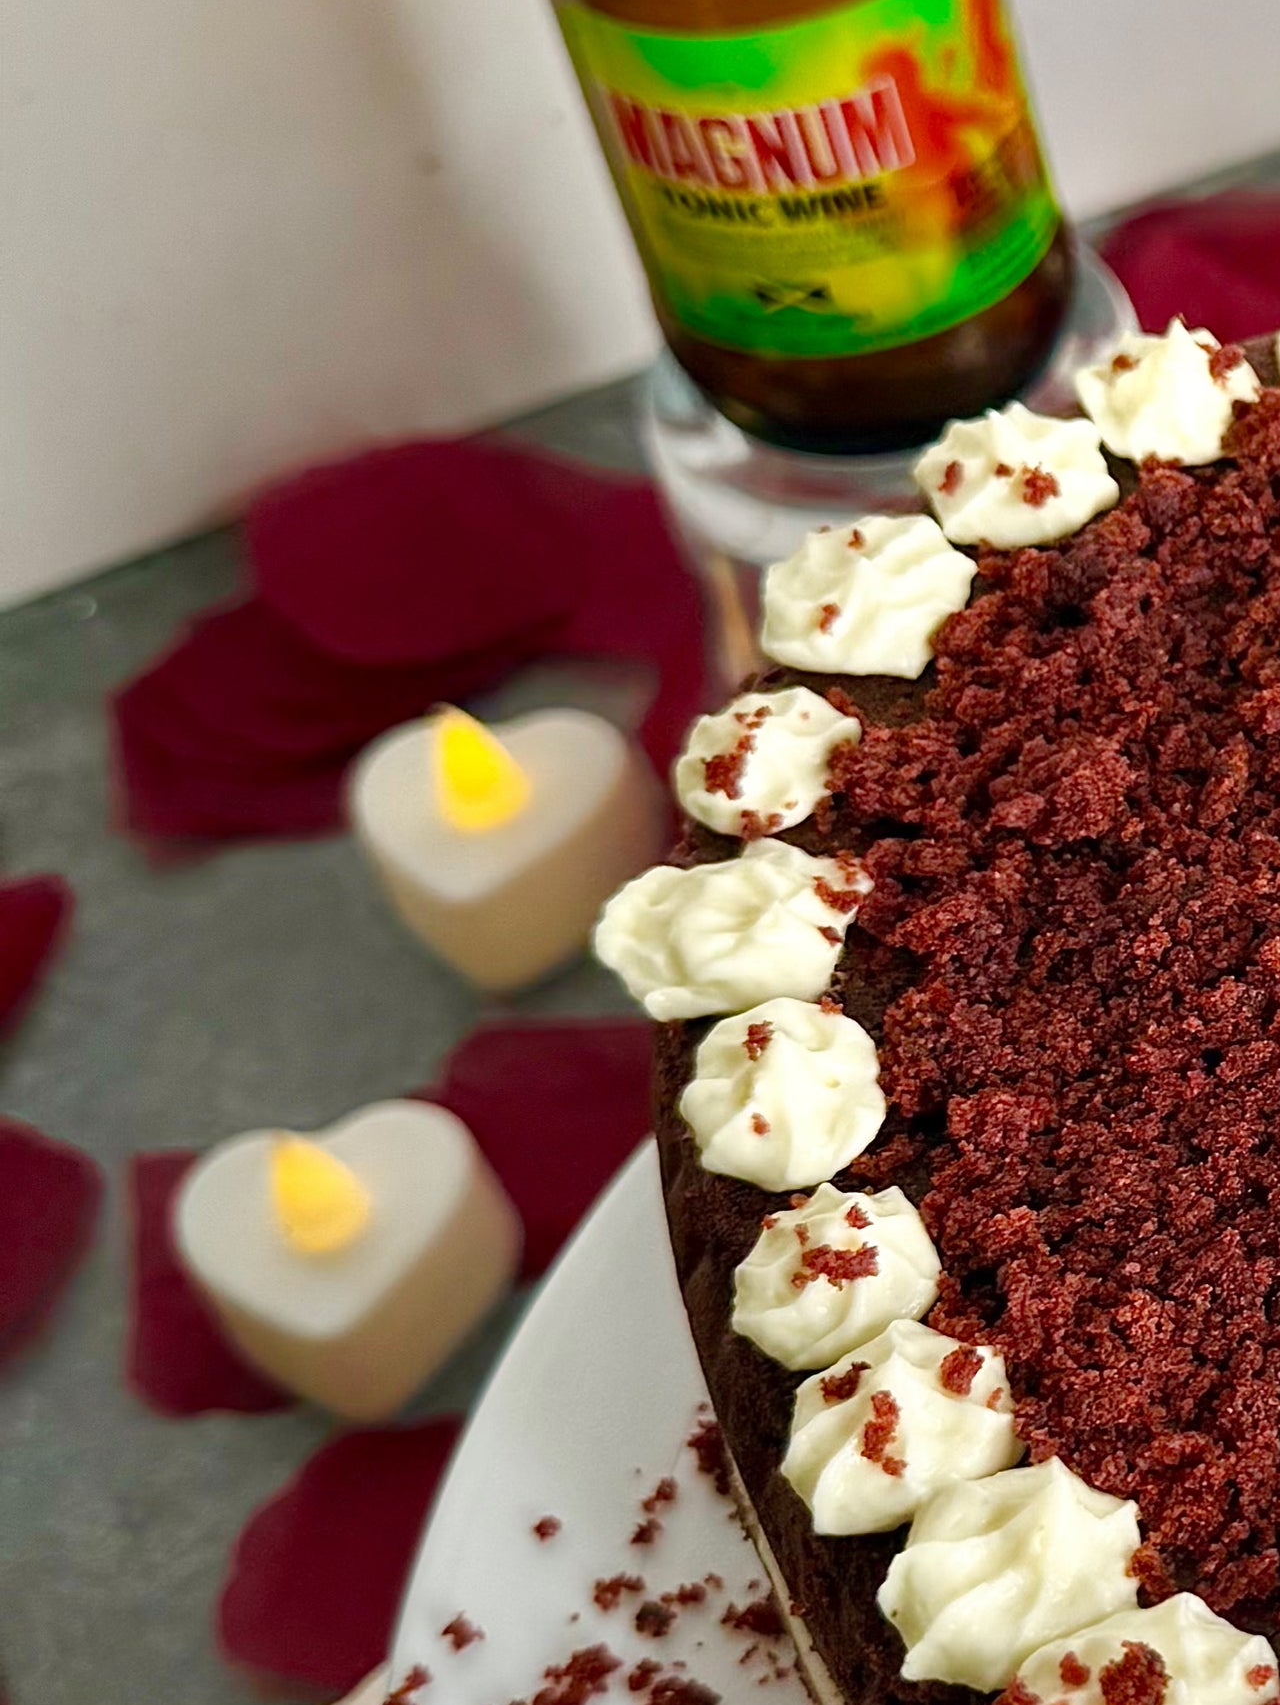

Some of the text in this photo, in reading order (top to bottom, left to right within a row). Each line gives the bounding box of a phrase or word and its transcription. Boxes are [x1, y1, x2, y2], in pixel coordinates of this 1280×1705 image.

[606, 74, 915, 193] MAGNUM
[664, 184, 888, 225] TONIC WINE
